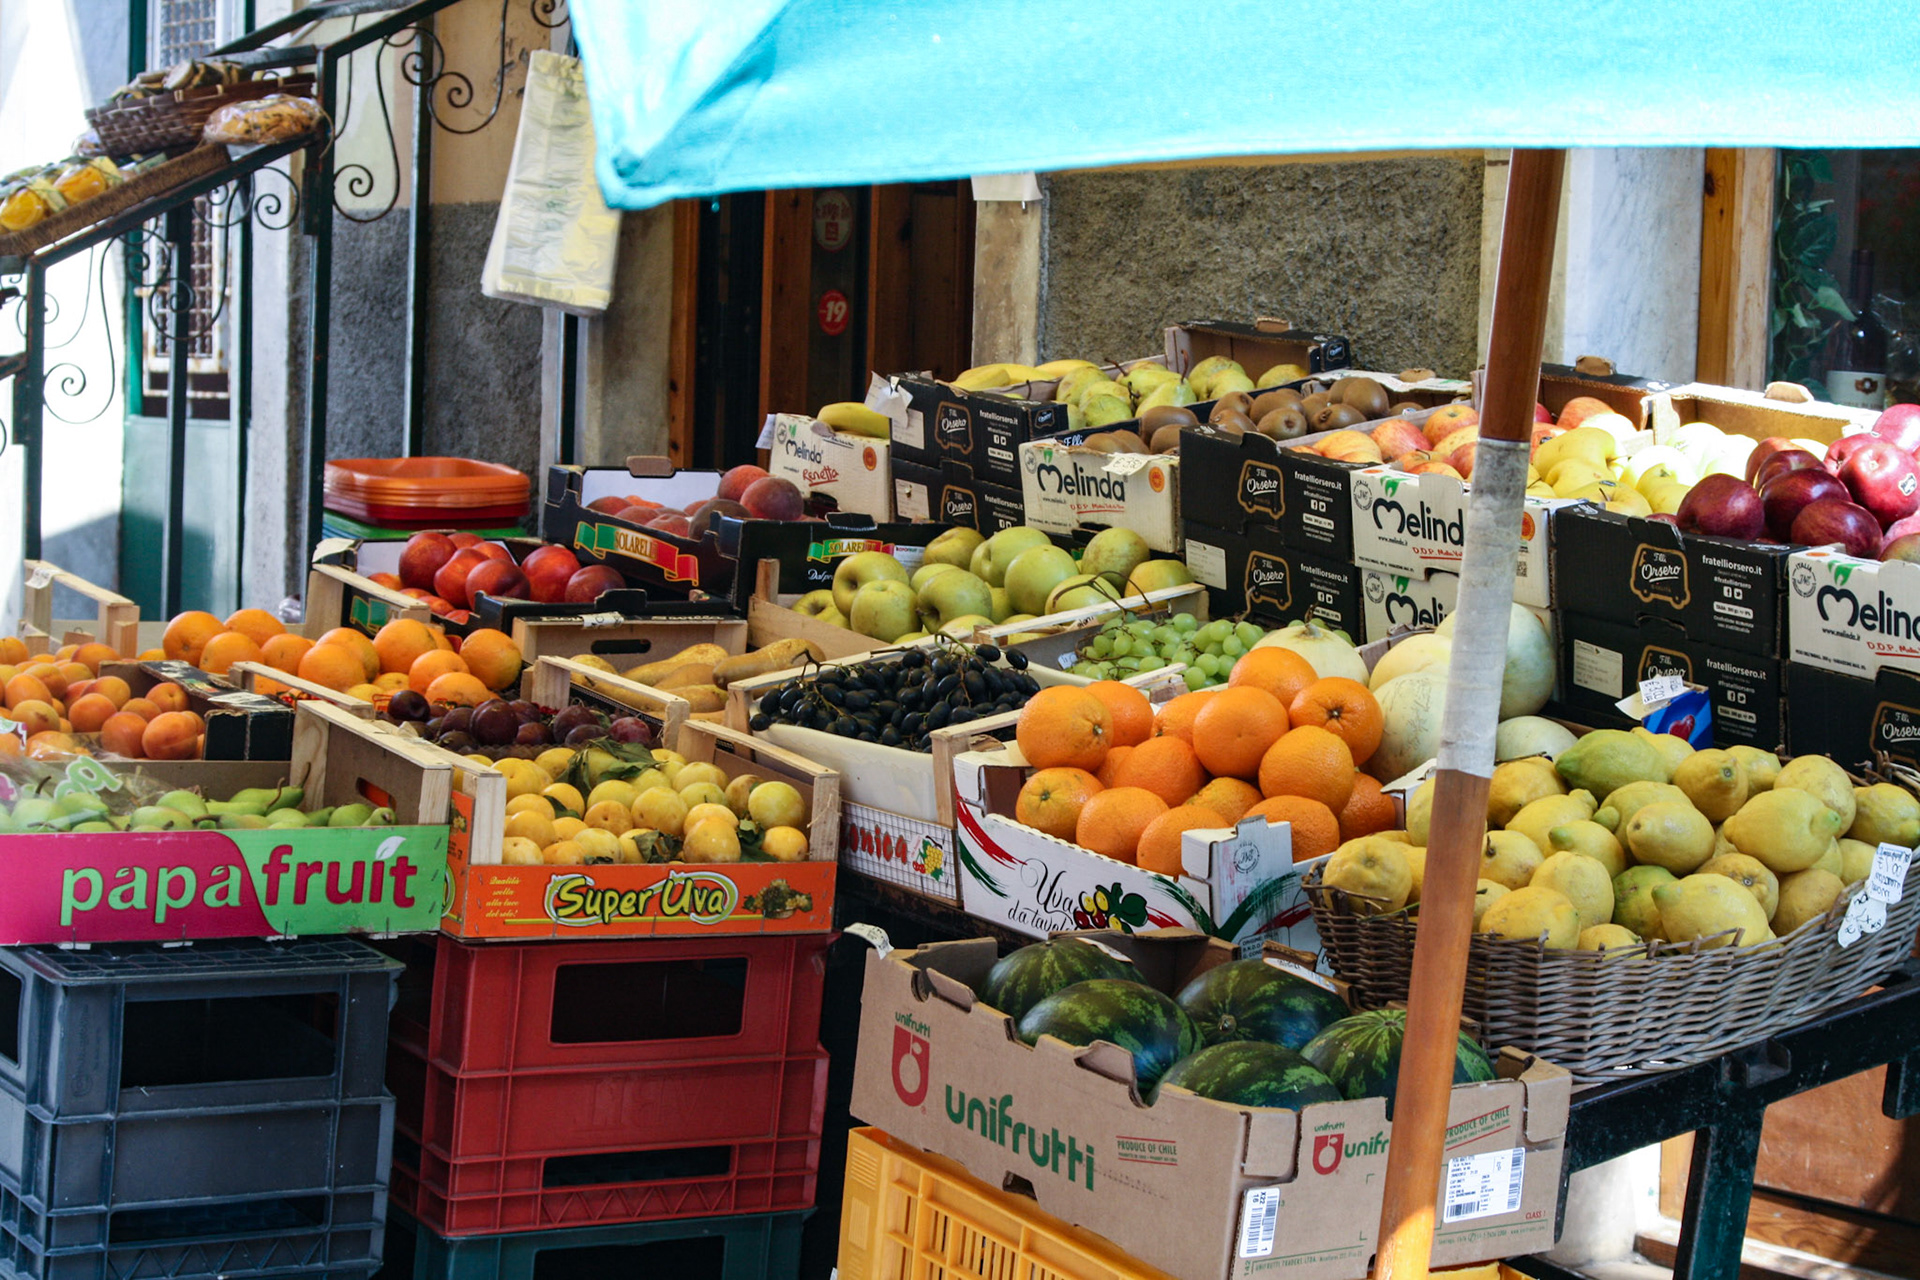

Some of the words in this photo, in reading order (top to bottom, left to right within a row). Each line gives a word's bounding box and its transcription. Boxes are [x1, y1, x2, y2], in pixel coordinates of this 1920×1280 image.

[941, 418, 967, 431] Orsero
[979, 409, 1019, 425] fratelliorsero.it
[785, 439, 823, 464] Melinda
[802, 465, 839, 482] Renetta
[1037, 462, 1126, 502] Melinda
[1294, 470, 1342, 491] fratelliorsero.it
[1246, 478, 1279, 493] Orsero
[946, 501, 973, 514] Orsero
[984, 494, 1024, 511] fratelliorsero.it
[1253, 568, 1285, 583] Orsero
[1300, 562, 1349, 583] fratelliorsero.it
[1641, 563, 1682, 580] Orsero
[1701, 554, 1763, 576] fratelliorsero.it
[1706, 658, 1767, 680] fratelliorsero.it
[59, 866, 242, 927] papa
[261, 842, 418, 909] fruit
[1021, 858, 1074, 914] Uva
[557, 875, 653, 924] Super
[660, 876, 727, 917] Uva
[1008, 900, 1028, 923] da
[894, 1010, 931, 1038] unifrutti
[1313, 1121, 1345, 1132] unifrutti
[1445, 1119, 1478, 1139] PRODUCE
[1478, 1114, 1489, 1125] OF
[1490, 1107, 1510, 1122] CHILE
[945, 1083, 1095, 1192] unifrutti
[1117, 1140, 1146, 1153] PRODUCE
[1147, 1143, 1157, 1153] OF
[1158, 1144, 1178, 1155] CHILE
[1344, 1130, 1390, 1158] unifr
[1525, 1211, 1542, 1220] CLASS
